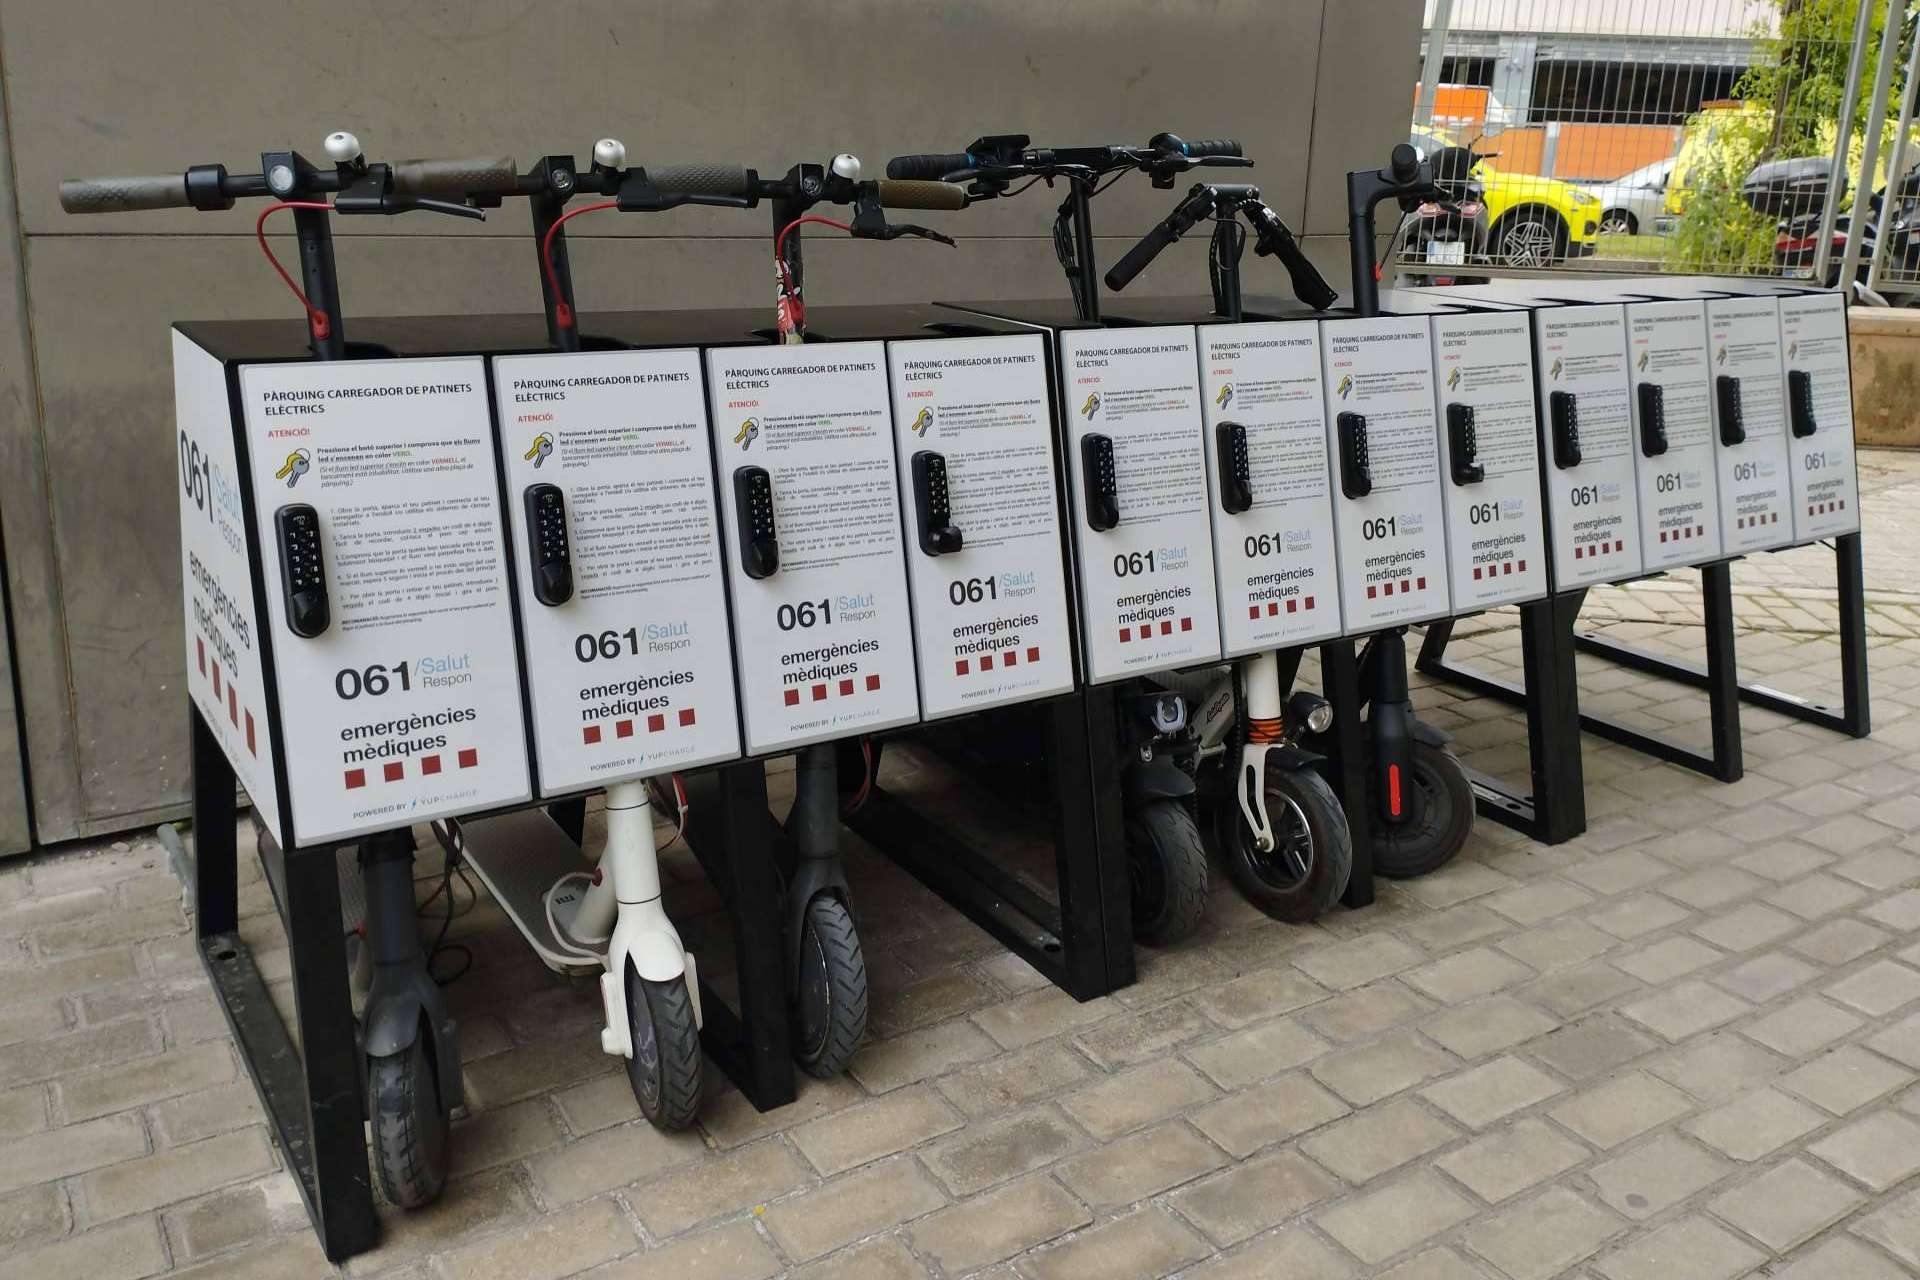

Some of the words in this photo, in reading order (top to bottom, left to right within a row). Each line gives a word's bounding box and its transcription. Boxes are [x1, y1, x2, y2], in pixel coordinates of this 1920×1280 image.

[1075, 349, 1109, 358] PÀRQUING
[1109, 346, 1152, 356] CARREGADOR
[1151, 346, 1161, 354] DE
[1160, 344, 1189, 353] PATINETS
[725, 368, 770, 378] PÀRQUING
[770, 365, 826, 376] CARREGADOR
[826, 364, 838, 373] DE
[839, 362, 876, 372] PATINETS
[904, 360, 943, 371] PÀRQUING
[943, 358, 993, 368] CARREGADOR
[992, 357, 1003, 365] DE
[1003, 355, 1036, 365] PATINETS
[1076, 359, 1109, 368] ELÈCTRICS
[513, 378, 566, 390] PÀRQUING
[567, 375, 632, 387] CARREGADOR
[632, 374, 646, 383] DE
[646, 372, 690, 383] PATINETS
[726, 380, 770, 391] ELÈCTRICS
[905, 372, 943, 382] ELÈCTRICS
[263, 390, 325, 402] PÀRQUING
[327, 386, 404, 399] CARREGADOR
[405, 385, 421, 395] DE
[422, 383, 472, 395] PATINETS
[514, 391, 566, 403] ELÈCTRICS
[264, 403, 325, 416] ELÈCTRICS
[267, 426, 311, 438] ATENCIÓ!
[181, 429, 213, 523] 061
[1734, 462, 1758, 483] 061
[1656, 473, 1682, 494] 061
[1571, 485, 1599, 508] 061
[1469, 501, 1500, 525] 061
[1363, 517, 1397, 542] 061
[1245, 533, 1282, 559] 061
[1113, 549, 1156, 578] 061
[1161, 560, 1189, 572] Respon
[1365, 549, 1426, 568] emergències
[1247, 567, 1314, 587] emergències
[190, 550, 249, 650] emergències
[949, 576, 998, 607] 061
[1004, 587, 1036, 599] Respon
[1116, 585, 1192, 608] emergències
[1248, 586, 1300, 602] mèdiques
[776, 598, 832, 632] 061
[839, 610, 876, 623] Respon
[1118, 605, 1175, 624] mèdiques
[193, 594, 238, 678] mèdiques
[953, 614, 1039, 639] emergències
[574, 626, 639, 663] 061
[648, 638, 690, 653] Respon
[781, 639, 880, 666] emergències
[955, 635, 1021, 656] mèdiques
[334, 660, 411, 701] 061
[422, 672, 472, 689] Respon
[783, 662, 858, 685] mèdiques
[579, 669, 694, 701] emergències
[581, 695, 670, 721] mèdiques
[340, 707, 477, 741] emergències
[343, 734, 447, 764] mèdiques
[590, 759, 625, 772] POWERED
[352, 805, 394, 819] POWERED
[396, 803, 406, 811] BY
